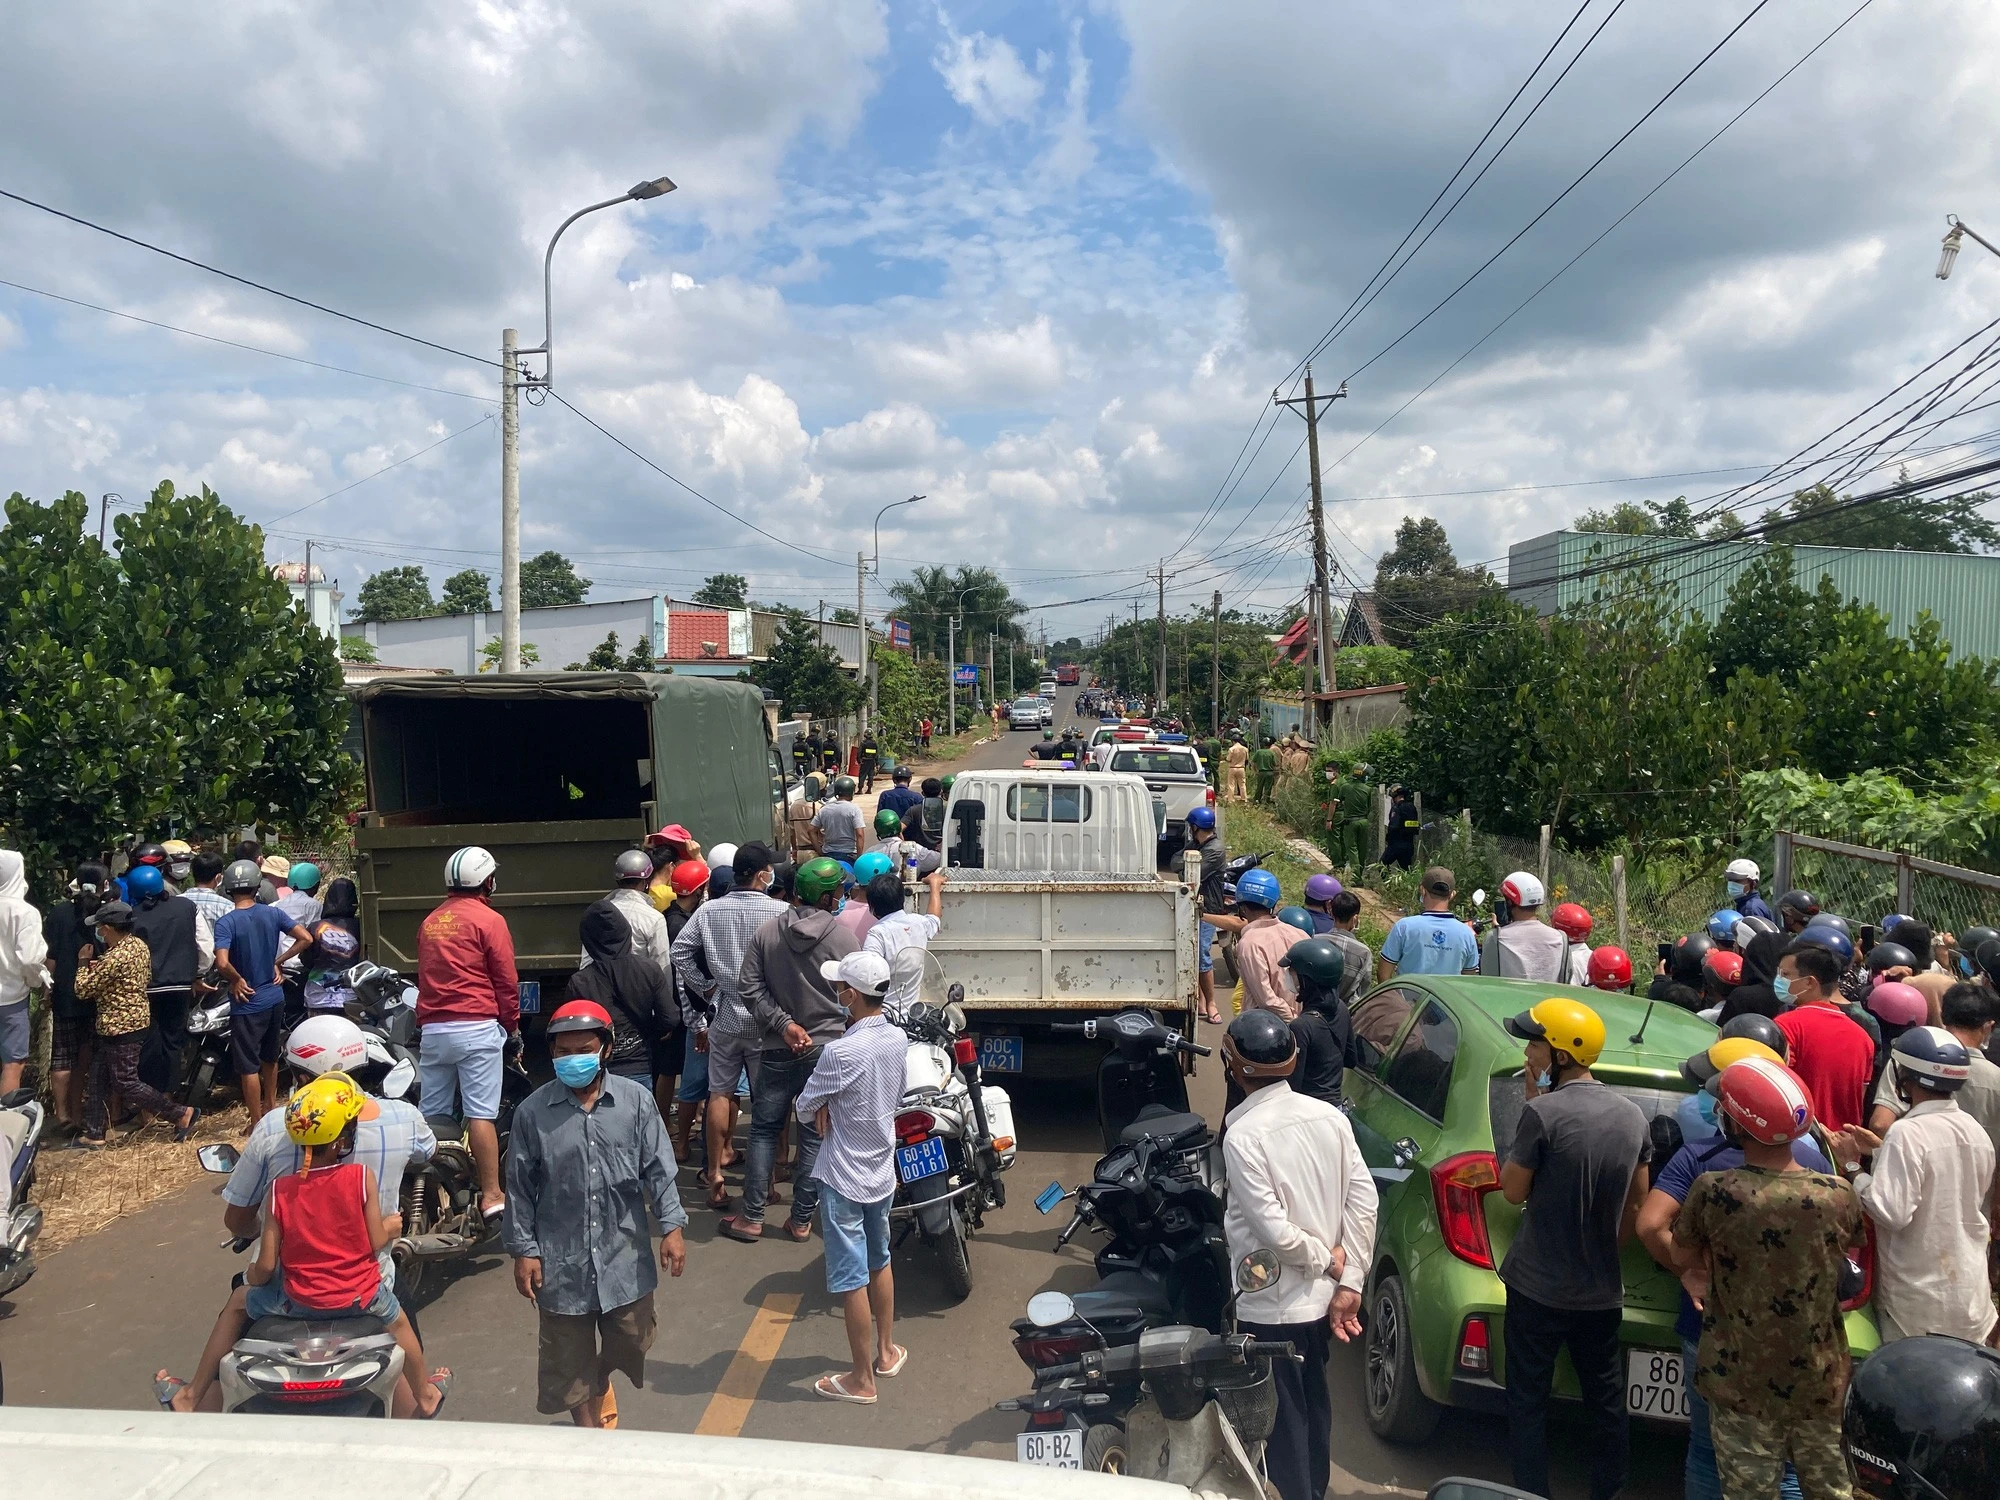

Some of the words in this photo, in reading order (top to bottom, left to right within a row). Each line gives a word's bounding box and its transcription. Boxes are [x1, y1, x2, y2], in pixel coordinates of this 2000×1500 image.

[984, 1038, 1012, 1053] 60C
[981, 1054, 1015, 1070] 1421
[904, 1141, 937, 1163] 60-B1
[903, 1154, 945, 1180] 001.61
[1649, 1356, 1684, 1387] 86
[1026, 1434, 1072, 1461] 60-B2
[1850, 1444, 1899, 1475] HONDA
